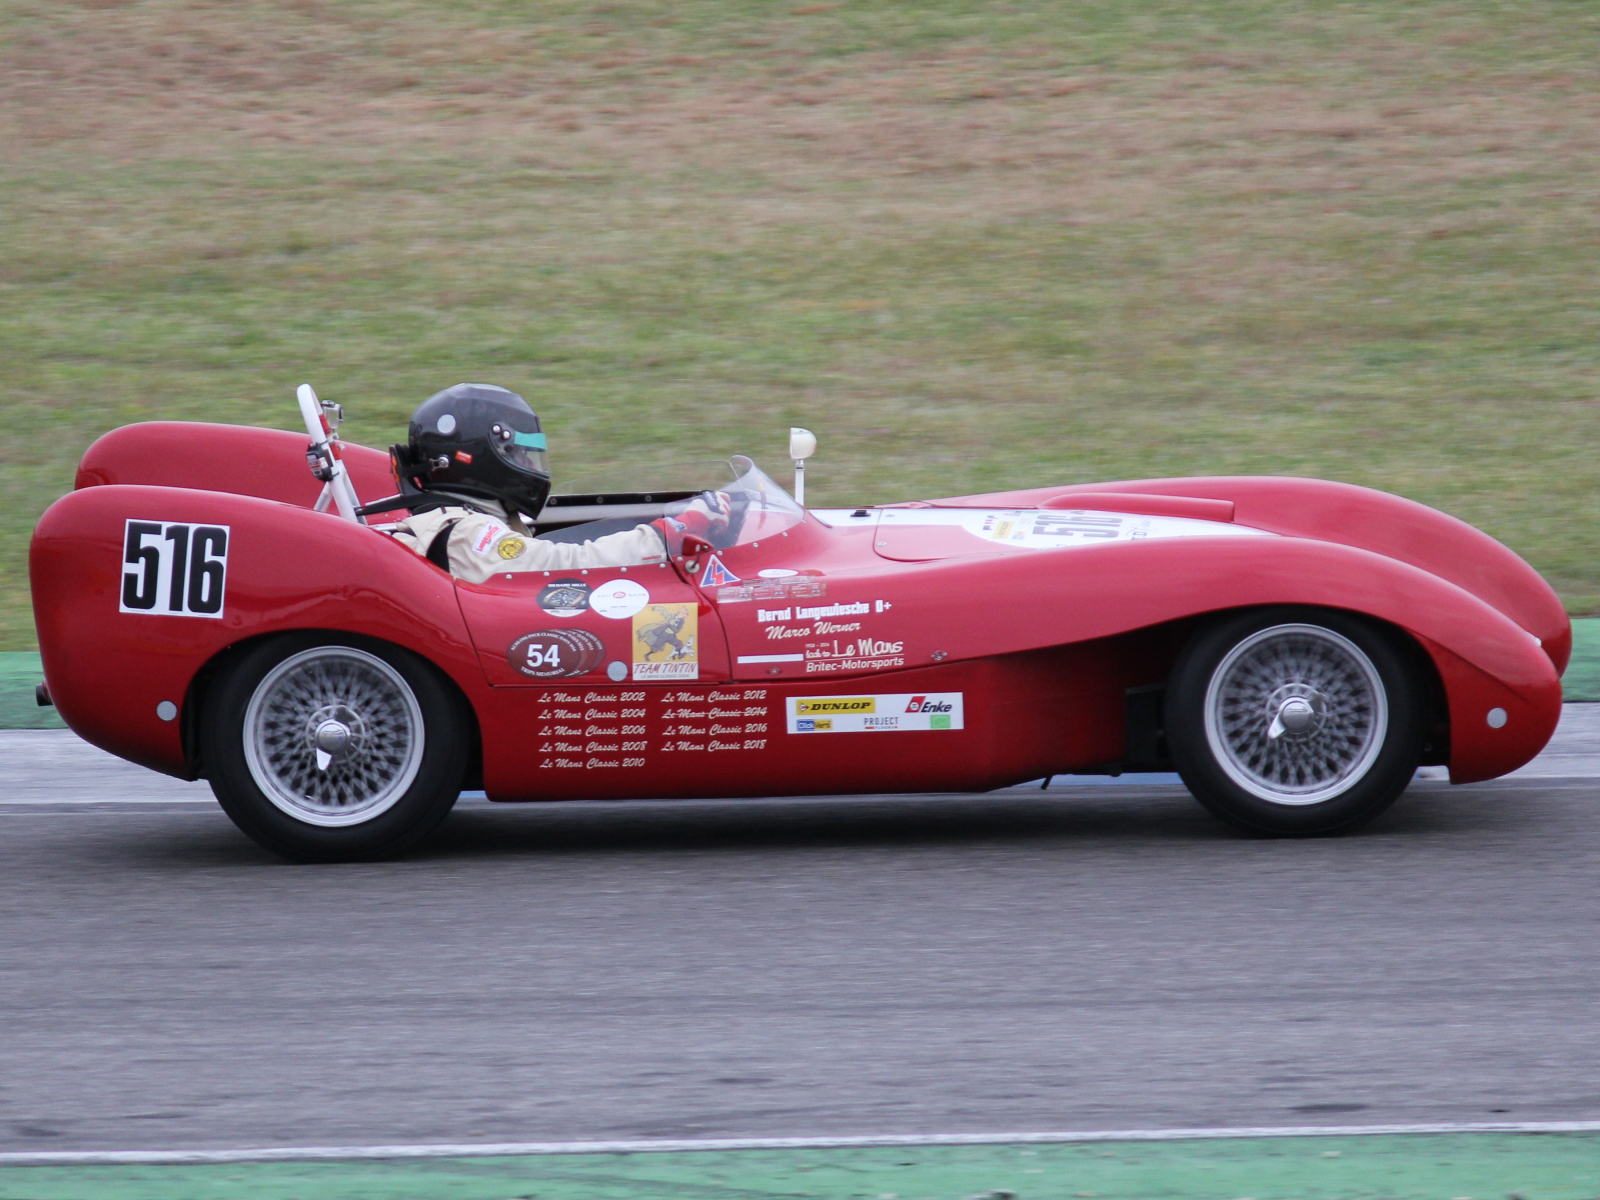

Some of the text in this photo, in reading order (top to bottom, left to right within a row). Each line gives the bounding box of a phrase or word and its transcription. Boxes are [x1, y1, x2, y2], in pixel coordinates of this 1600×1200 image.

[122, 521, 227, 614] 516
[757, 607, 791, 622] Bernd
[795, 601, 870, 620] Langewiesche
[765, 621, 861, 639] Marco Werner
[831, 640, 856, 657] Le
[858, 638, 904, 656] Mans
[526, 643, 560, 667] 54
[634, 662, 698, 674] TEAM TINTIN
[806, 657, 904, 673] Britec-Motorsports
[537, 691, 646, 704] Le Mans Classic 2002
[661, 690, 767, 703] Le Mans Classic 2012
[661, 707, 768, 719] Le Mans Classic 2014
[811, 702, 871, 711] DUNLOP
[921, 701, 952, 713] Enke
[538, 708, 646, 720] Le Mans Classic 2004
[864, 716, 899, 726] PROJECT
[538, 725, 646, 737] Le Mans Classic 2006
[662, 723, 768, 736] Le Mans Classic 2016
[539, 741, 648, 753] Le Mans Classic 2008
[661, 739, 767, 752] Le Mans Classic 2018
[539, 758, 645, 769] Le Mans Classic 2010
